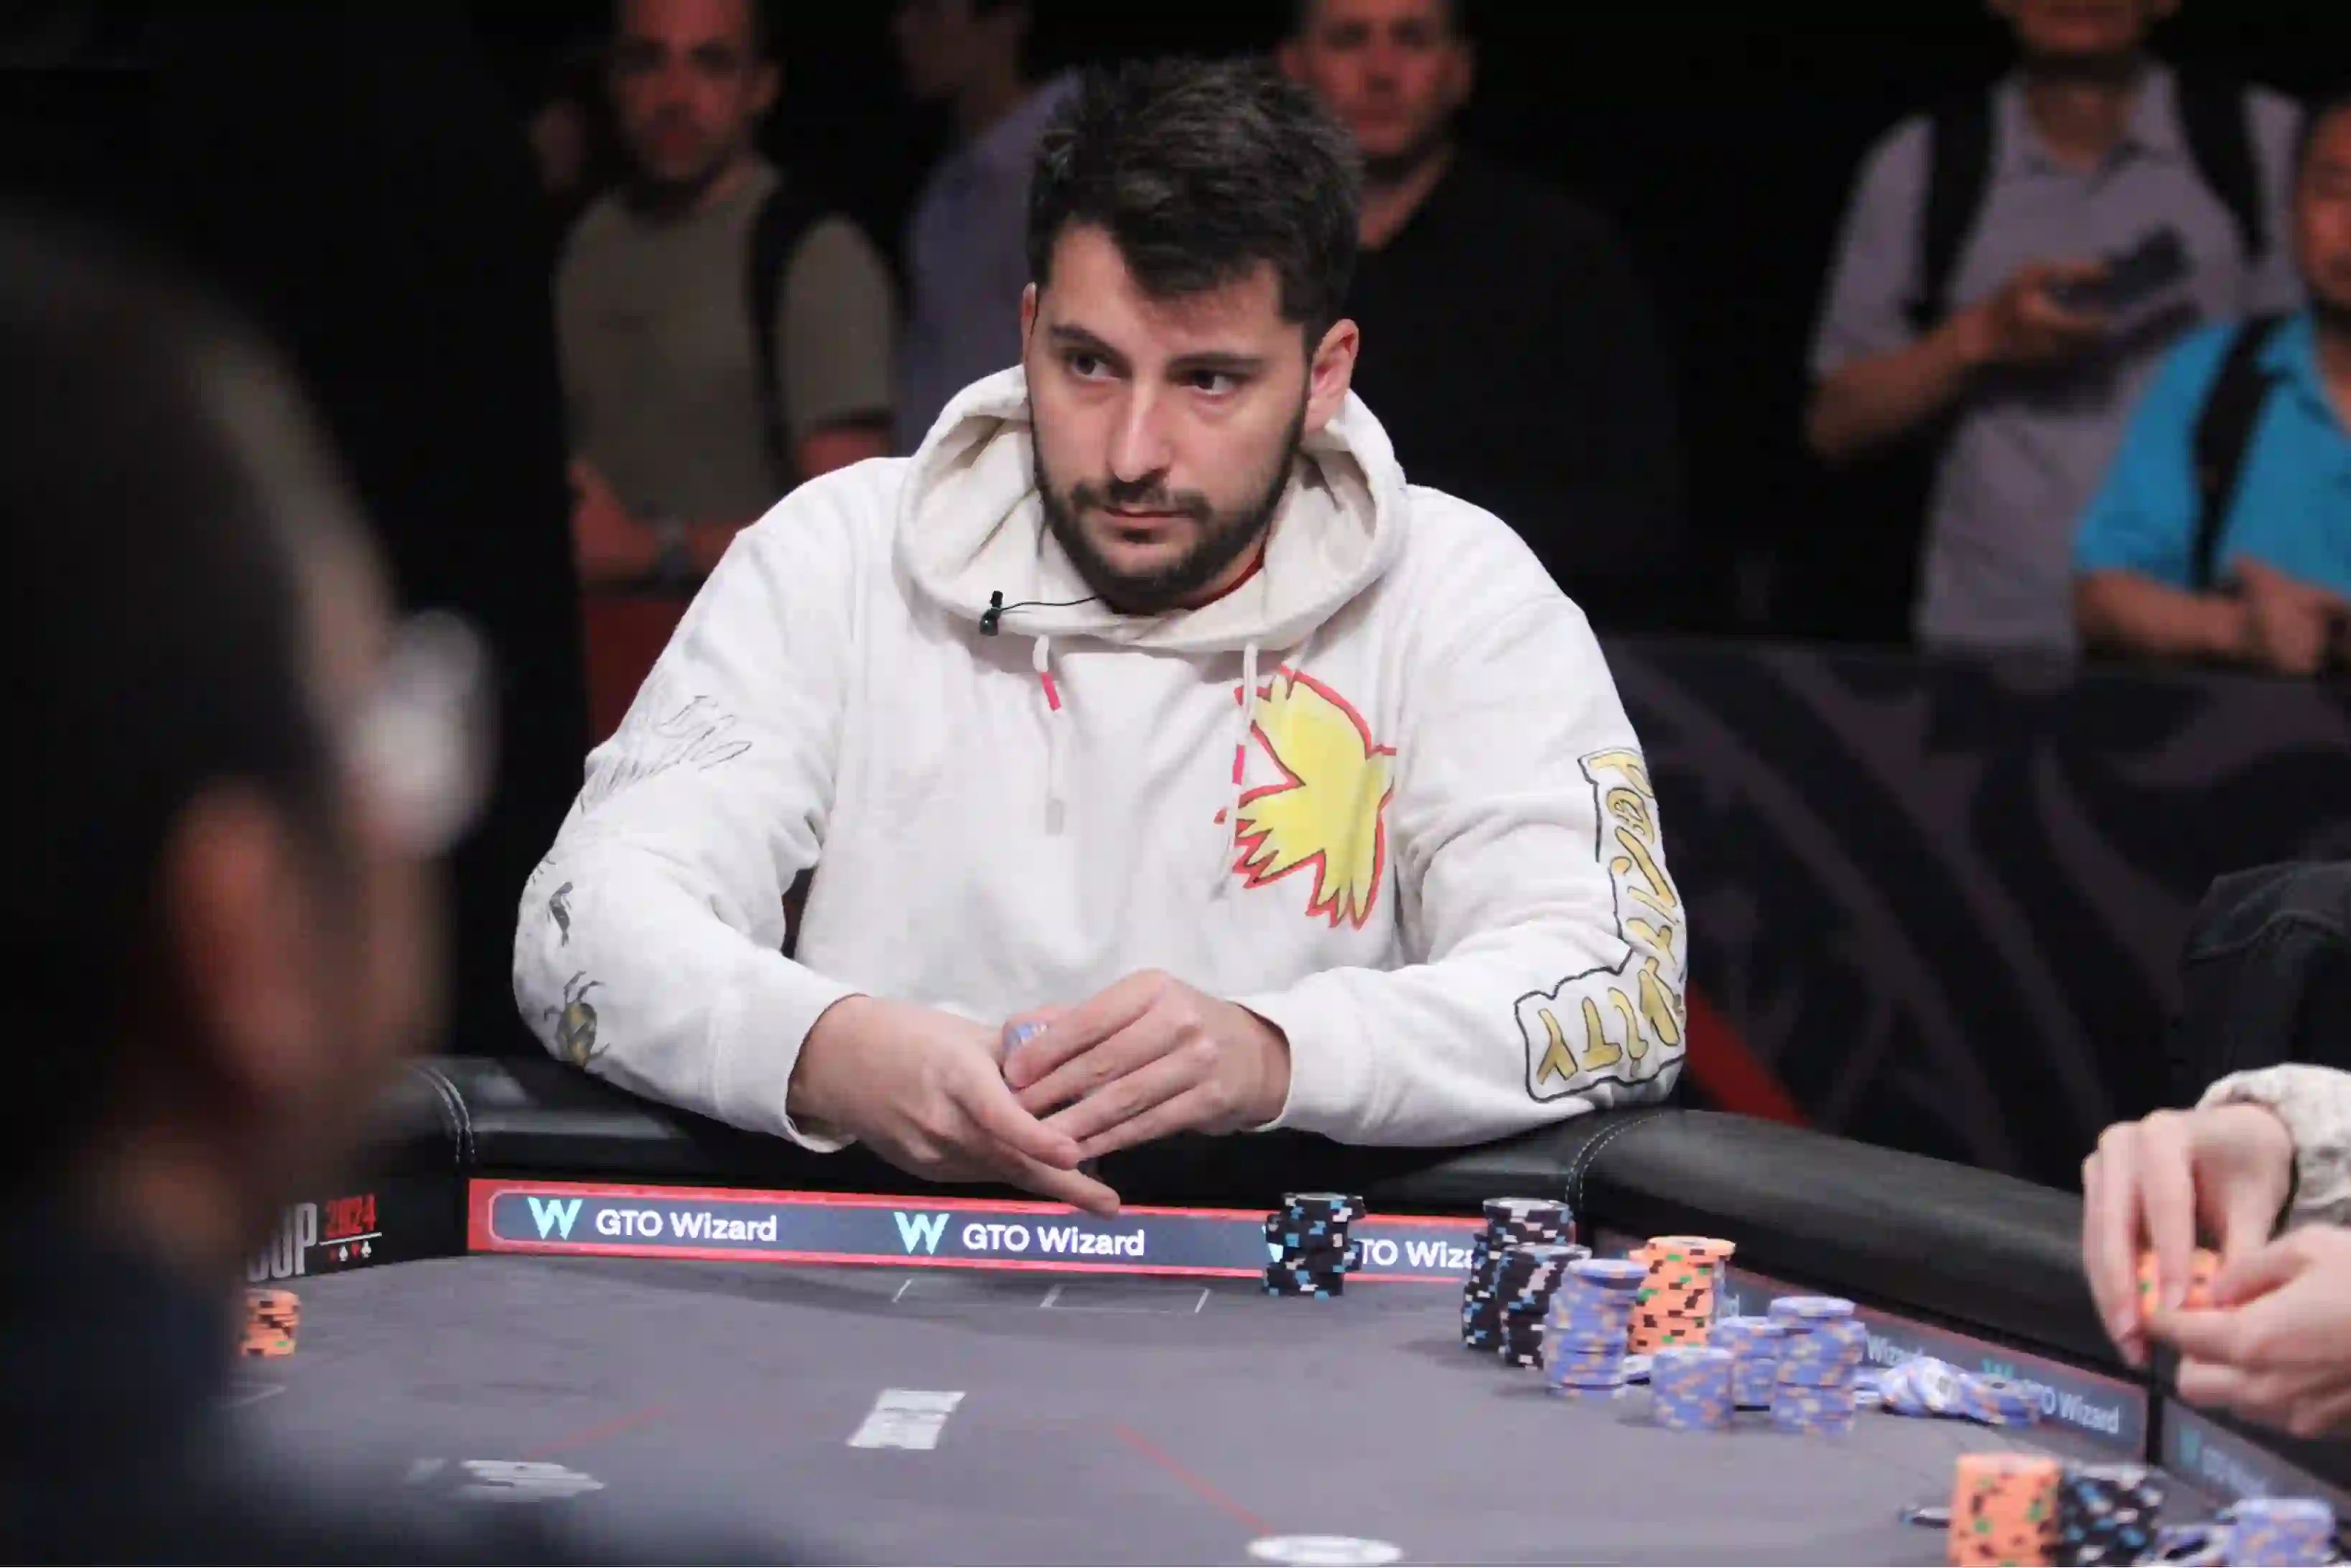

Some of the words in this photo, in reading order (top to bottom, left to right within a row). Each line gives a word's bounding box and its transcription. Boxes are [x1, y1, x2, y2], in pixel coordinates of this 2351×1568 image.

[595, 1209, 664, 1237] GTO
[669, 1212, 777, 1242] Wizard
[962, 1223, 1030, 1251] GTO
[1037, 1226, 1145, 1256] Wizard
[1353, 1238, 1398, 1266] TO
[1405, 1240, 1474, 1269] Wiz
[2058, 1391, 2119, 1434] Wizard
